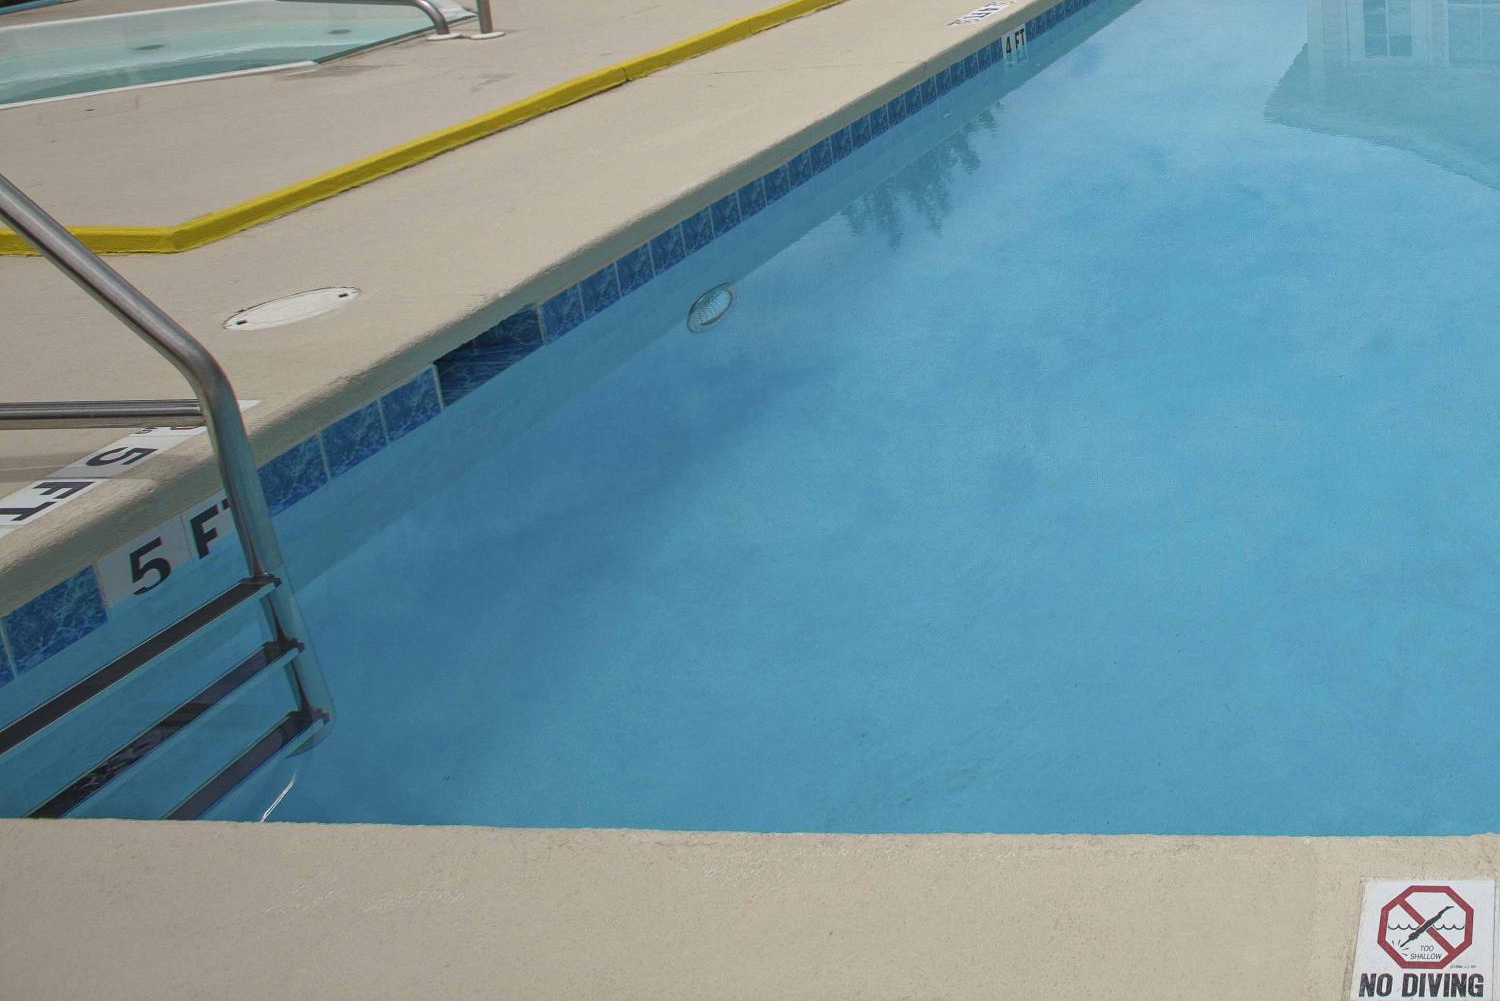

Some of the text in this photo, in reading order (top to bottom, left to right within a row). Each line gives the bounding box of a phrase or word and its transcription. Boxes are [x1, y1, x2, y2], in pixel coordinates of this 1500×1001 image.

[1006, 37, 1011, 53] 4
[85, 446, 160, 467] 5
[129, 498, 231, 596] 5 F
[1409, 952, 1443, 960] SHALLOW
[1420, 944, 1435, 952] TOO
[1358, 973, 1485, 998] NO DIVING
